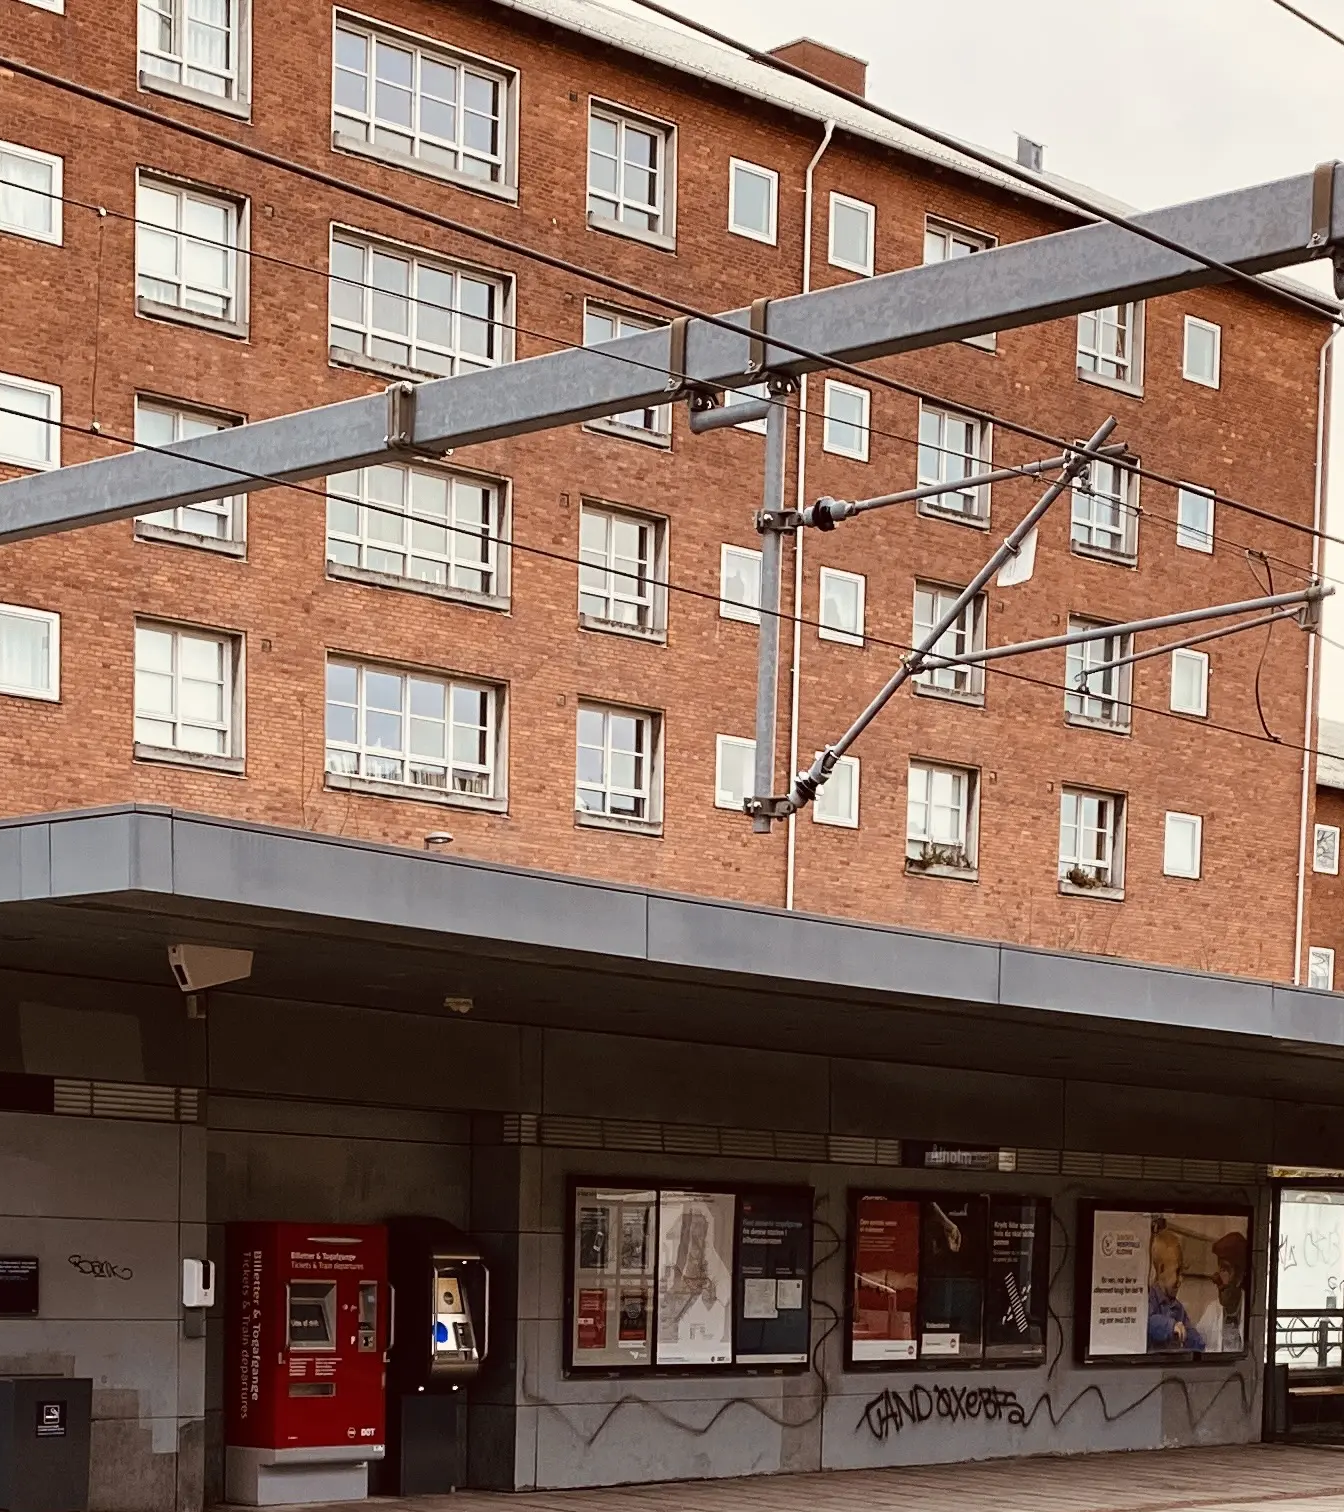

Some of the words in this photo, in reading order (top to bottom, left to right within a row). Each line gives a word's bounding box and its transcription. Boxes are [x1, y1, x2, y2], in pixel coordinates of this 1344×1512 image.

[242, 1251, 251, 1296] Tickets
[241, 1315, 251, 1346] Train
[240, 1349, 251, 1420] departures
